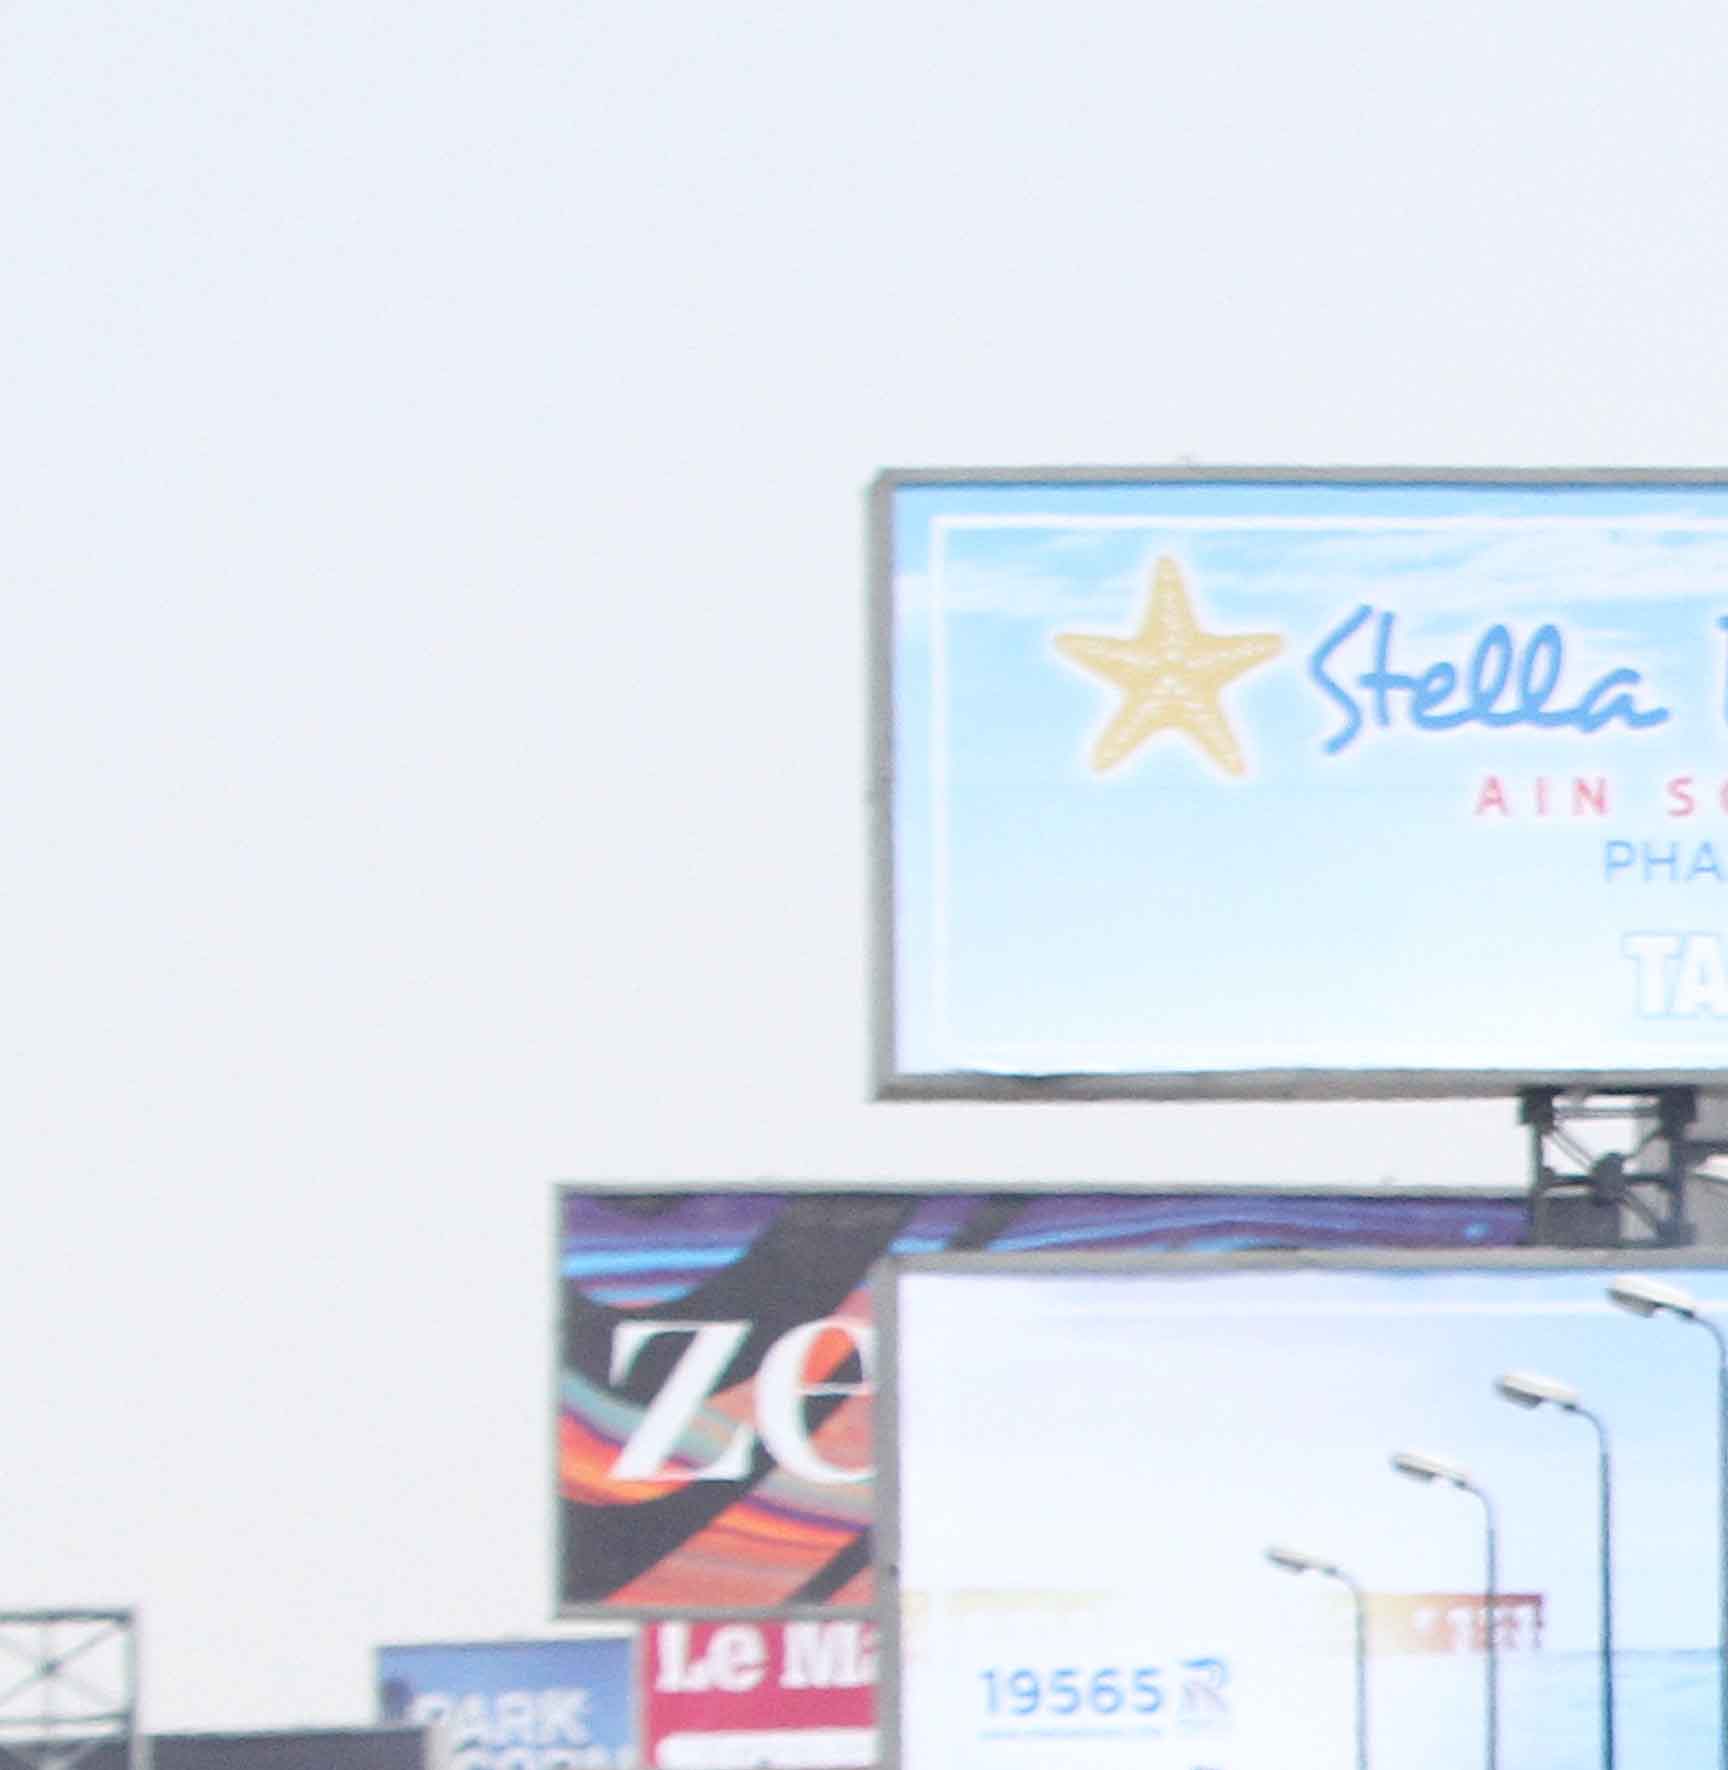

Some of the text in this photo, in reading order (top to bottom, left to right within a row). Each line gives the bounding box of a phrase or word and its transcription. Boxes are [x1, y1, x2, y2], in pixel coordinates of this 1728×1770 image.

[1310, 603, 1669, 755] Stella
[1476, 776, 1610, 816] AIN
[977, 1665, 1167, 1716] 19565
